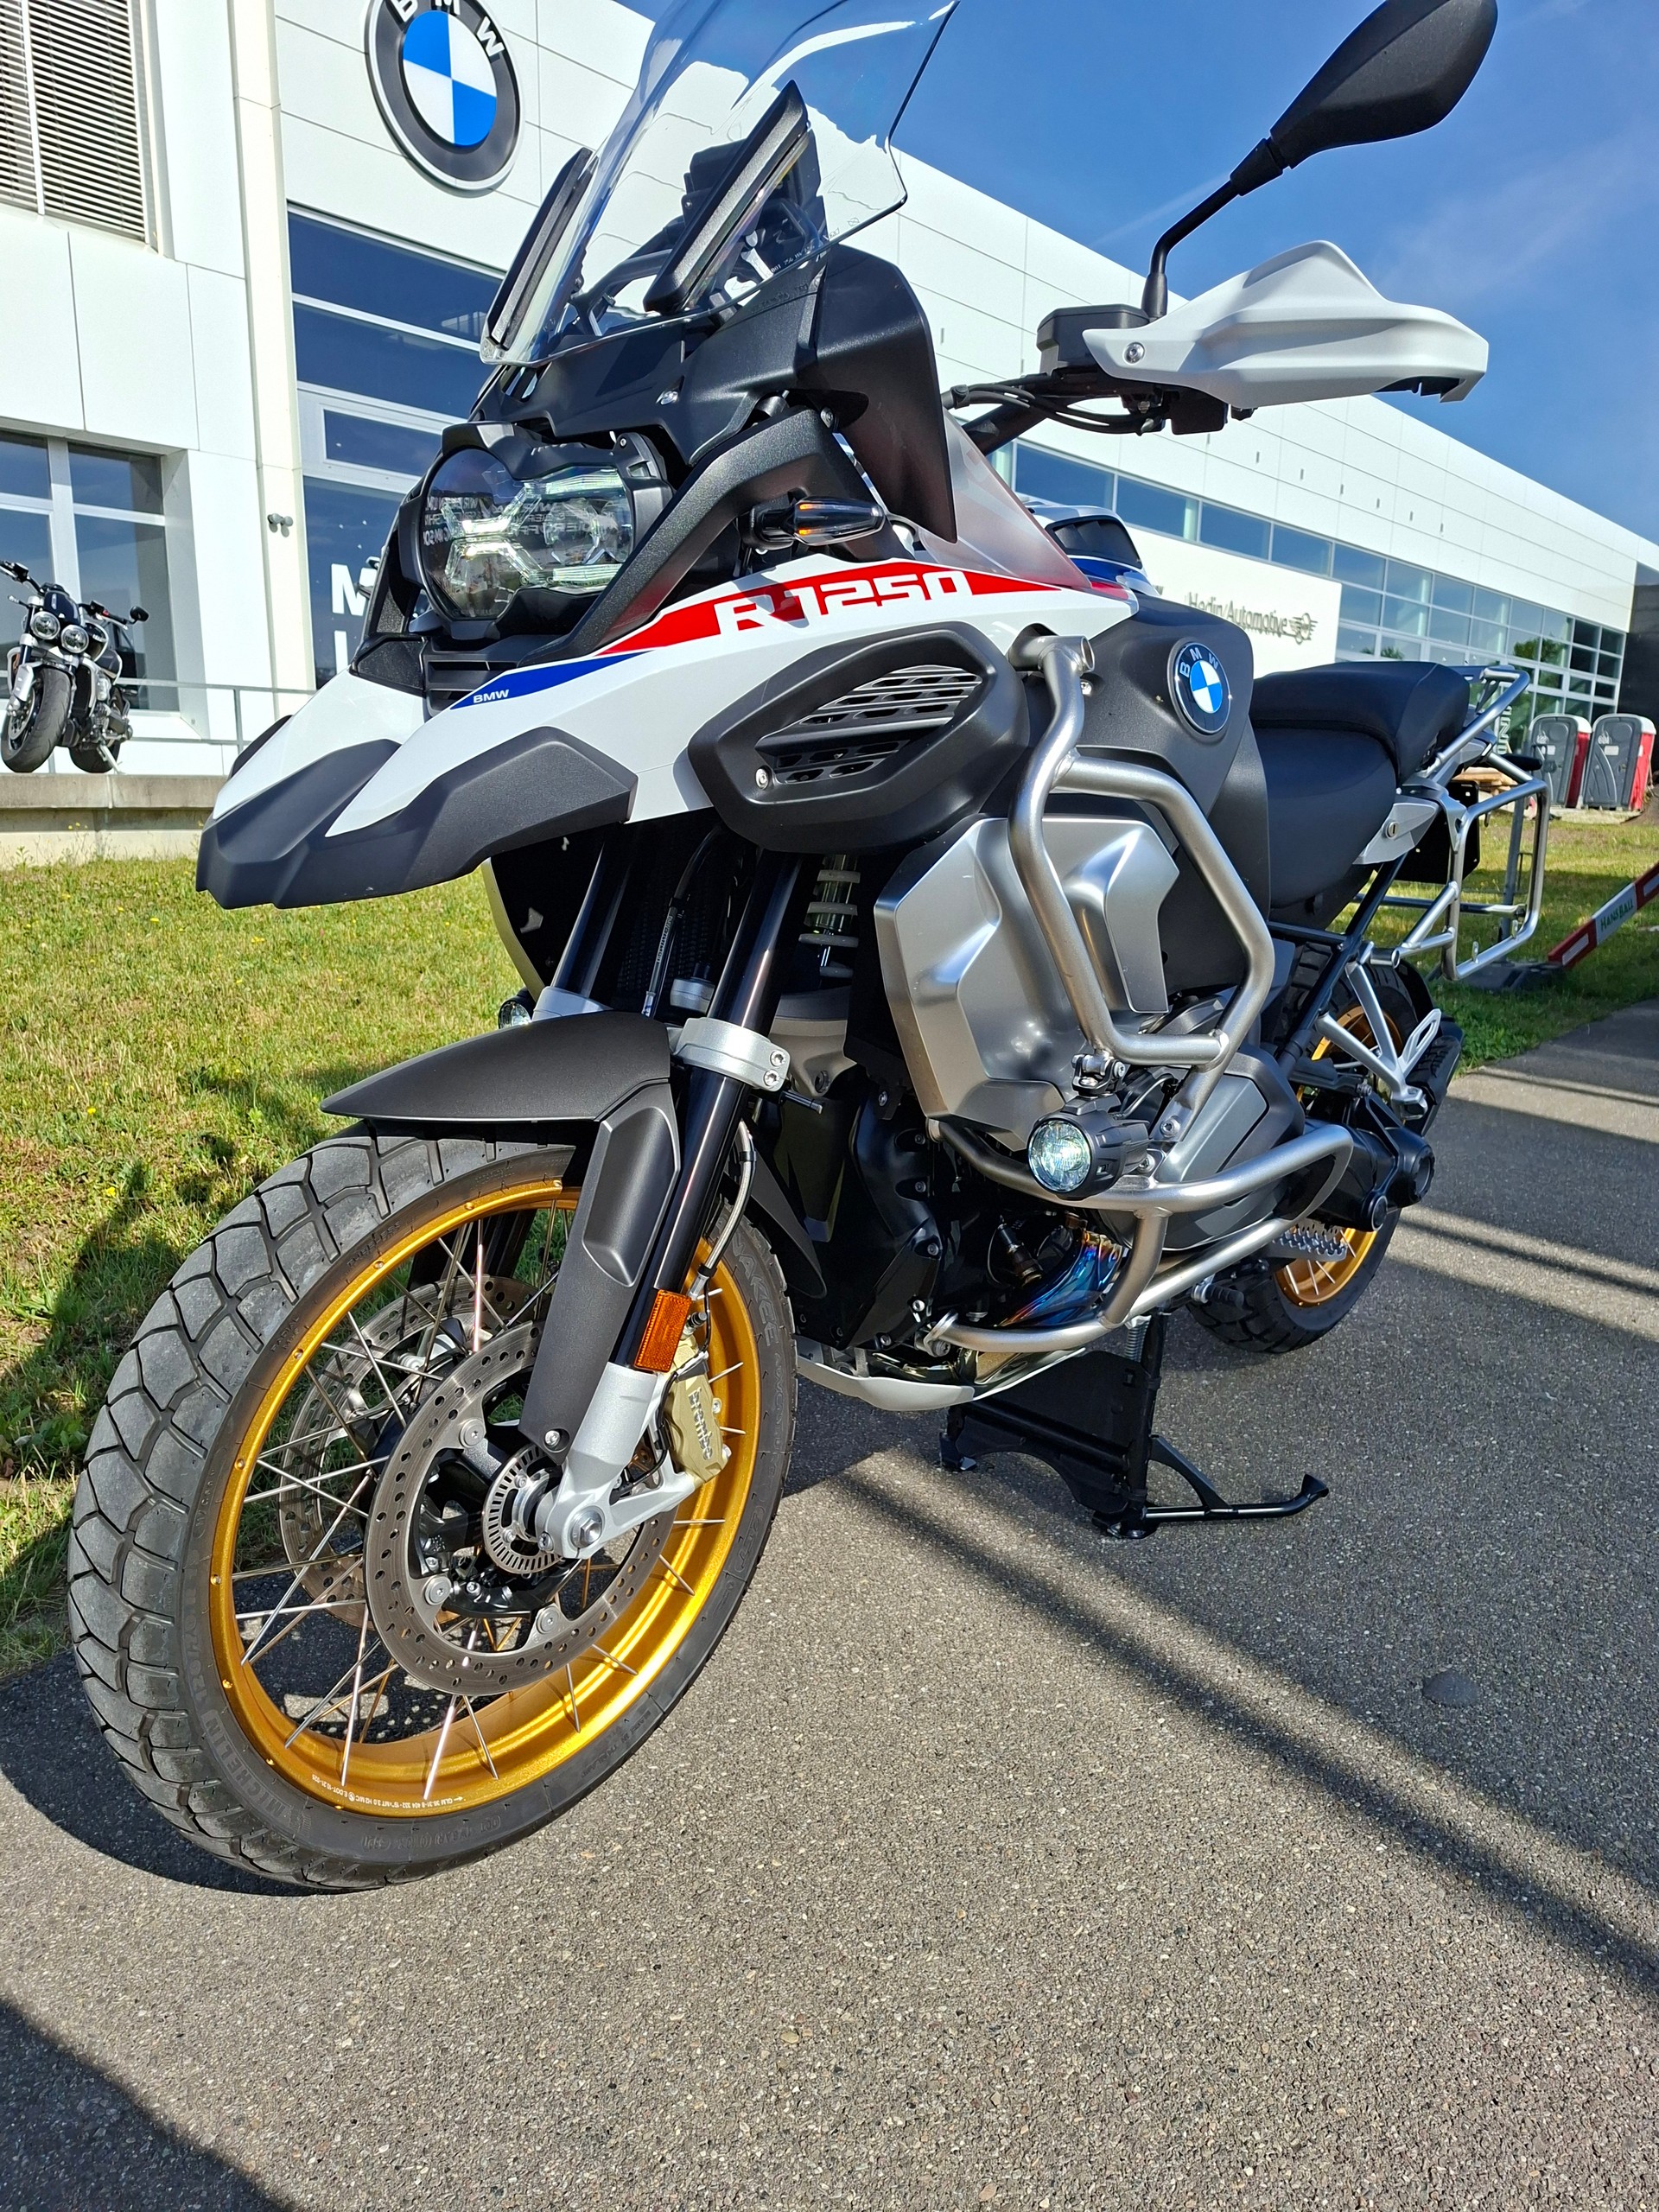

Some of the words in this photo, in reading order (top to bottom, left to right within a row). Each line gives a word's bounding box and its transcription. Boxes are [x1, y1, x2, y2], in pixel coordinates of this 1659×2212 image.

[714, 593, 776, 635] R
[784, 570, 975, 624] 1250
[1179, 647, 1219, 678] BMW
[473, 689, 510, 703] BMW
[346, 1221, 400, 1267] TUBELESS
[270, 1316, 300, 1353] RADIAL
[687, 1385, 715, 1461] brembo
[203, 1714, 288, 1819] MICHELIN
